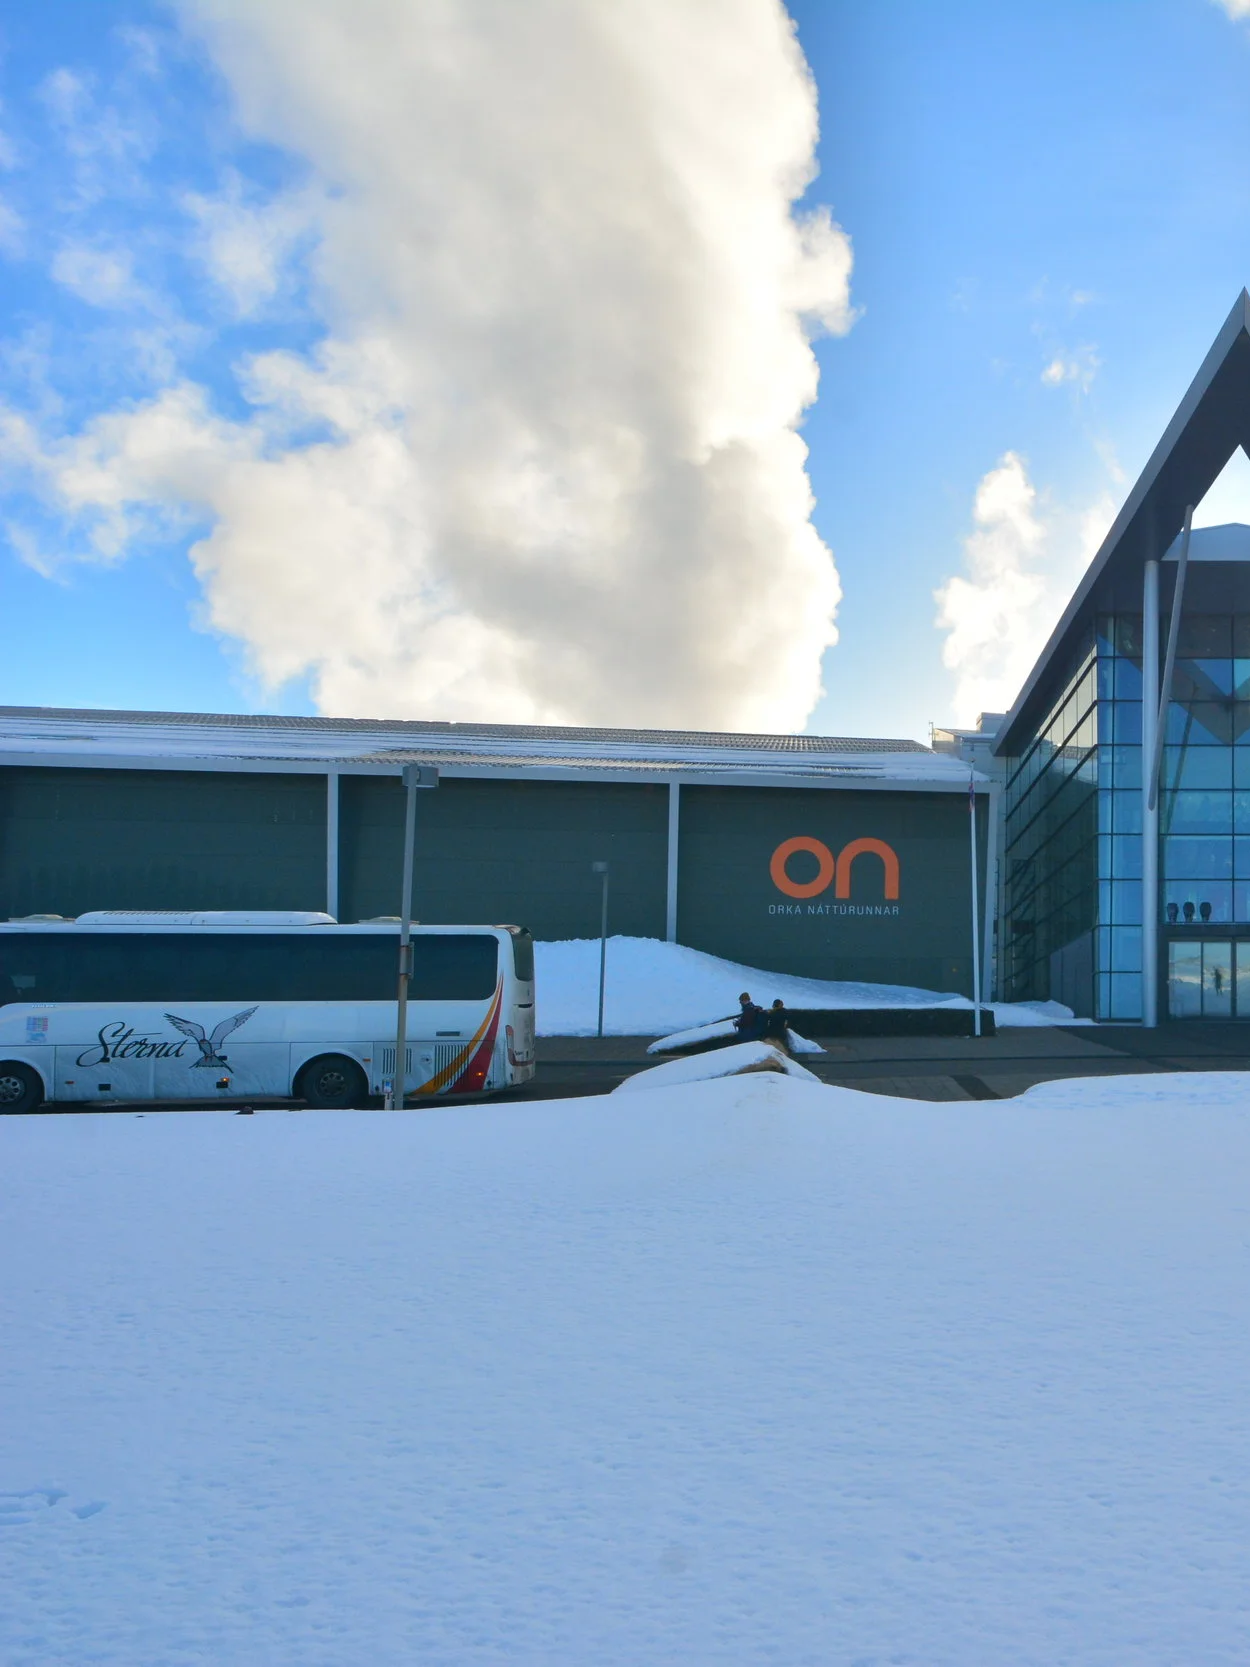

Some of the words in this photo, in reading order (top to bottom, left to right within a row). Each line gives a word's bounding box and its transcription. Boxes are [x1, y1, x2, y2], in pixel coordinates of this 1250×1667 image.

[769, 836, 900, 900] on
[768, 904, 802, 915] ORKA
[807, 903, 900, 916] NÁTTÚRUNNAR
[75, 1021, 189, 1068] Sterna
